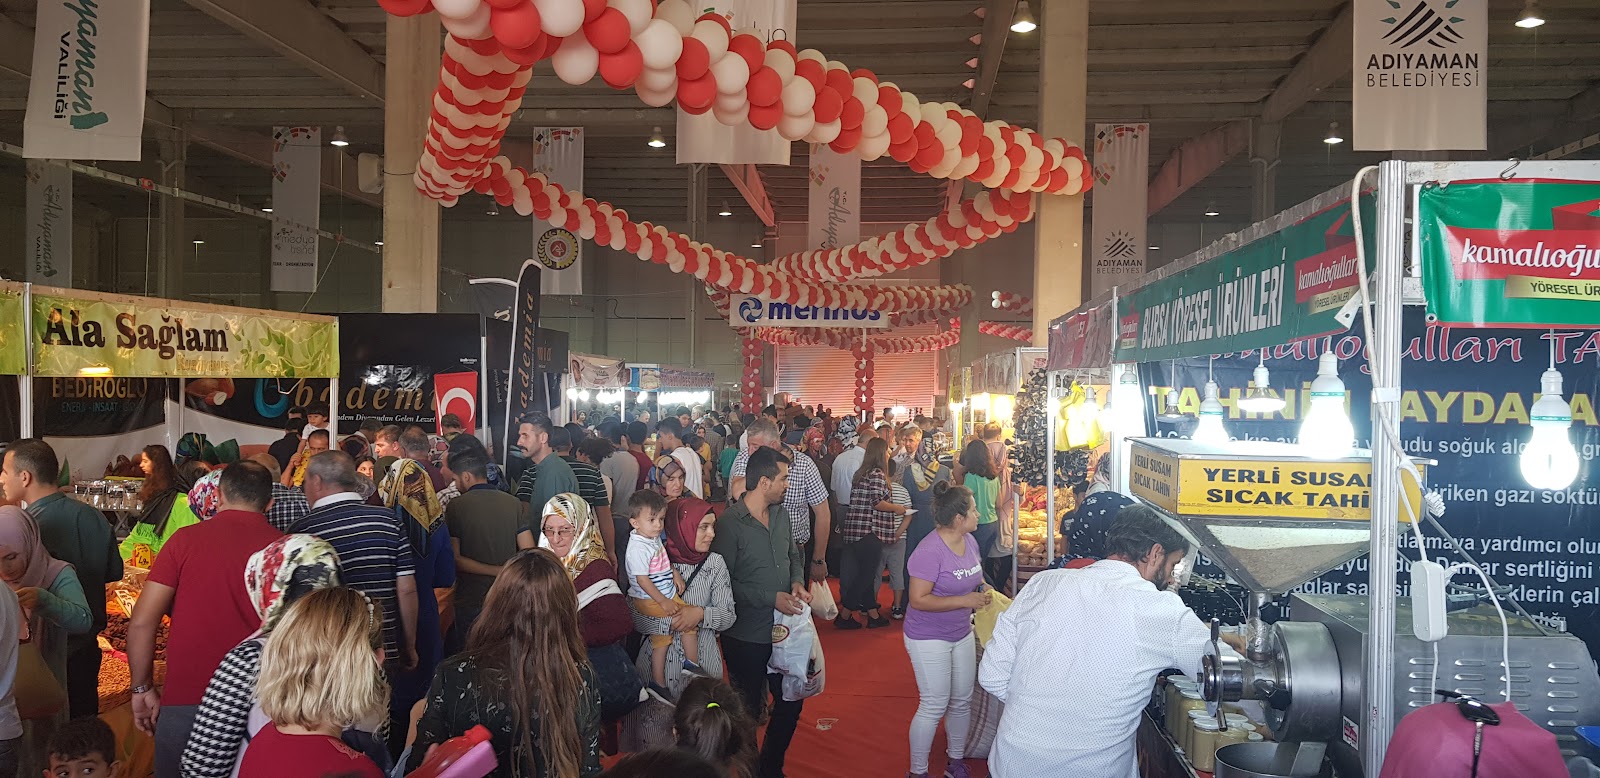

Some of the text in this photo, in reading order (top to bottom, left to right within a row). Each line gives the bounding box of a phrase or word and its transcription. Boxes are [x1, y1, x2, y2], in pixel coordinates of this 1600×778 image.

[1367, 53, 1479, 69] ADIYAMAN
[54, 31, 70, 119] VALİLİĞİ
[1367, 70, 1479, 87] BELEDİYESİ
[1096, 267, 1143, 275] BELEDİYESİ
[1141, 247, 1287, 350] BURSA YÖRESEL ÜRÜNLERİ
[1530, 281, 1583, 296] YÖRESEL
[43, 308, 229, 360] Ala Sağlam
[1438, 437, 1496, 458] soğuk
[1203, 466, 1371, 488] YERLİ SUSA
[1206, 489, 1371, 509] SICAK TAHİ
[1494, 487, 1536, 507] gazı
[1480, 535, 1561, 555] yardımcı
[1505, 560, 1593, 583] sertliğini
